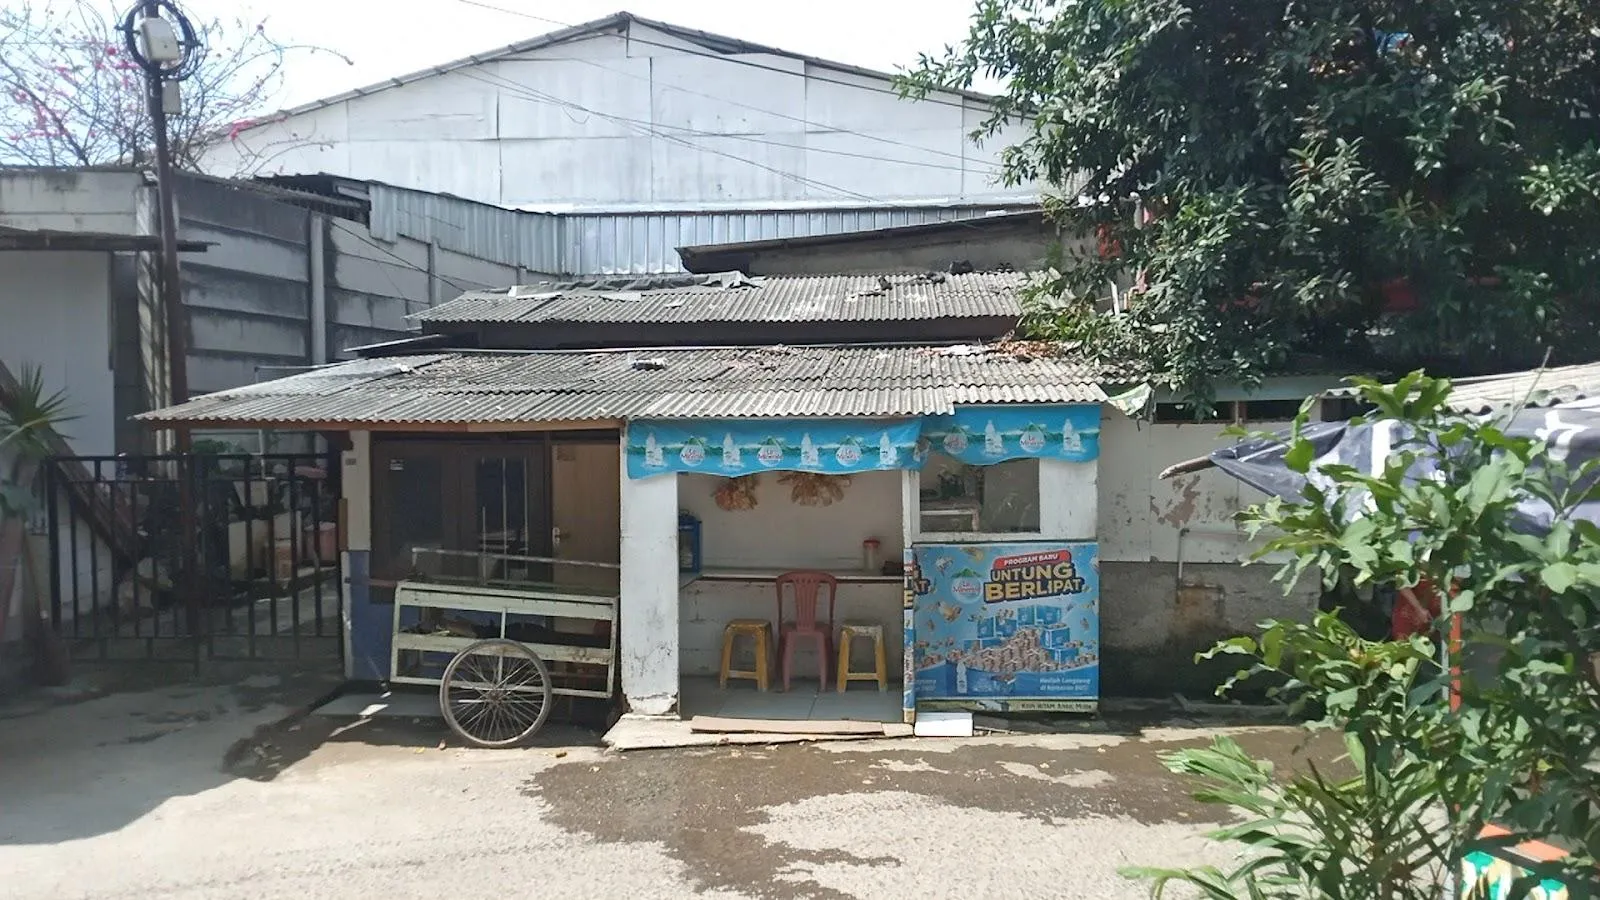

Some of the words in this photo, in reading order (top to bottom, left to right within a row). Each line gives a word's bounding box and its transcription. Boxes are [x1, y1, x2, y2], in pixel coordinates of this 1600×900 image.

[1003, 556, 1038, 566] PROGRAM
[992, 562, 1073, 582] UNTUNG
[985, 578, 1081, 601] BERLIPAT
